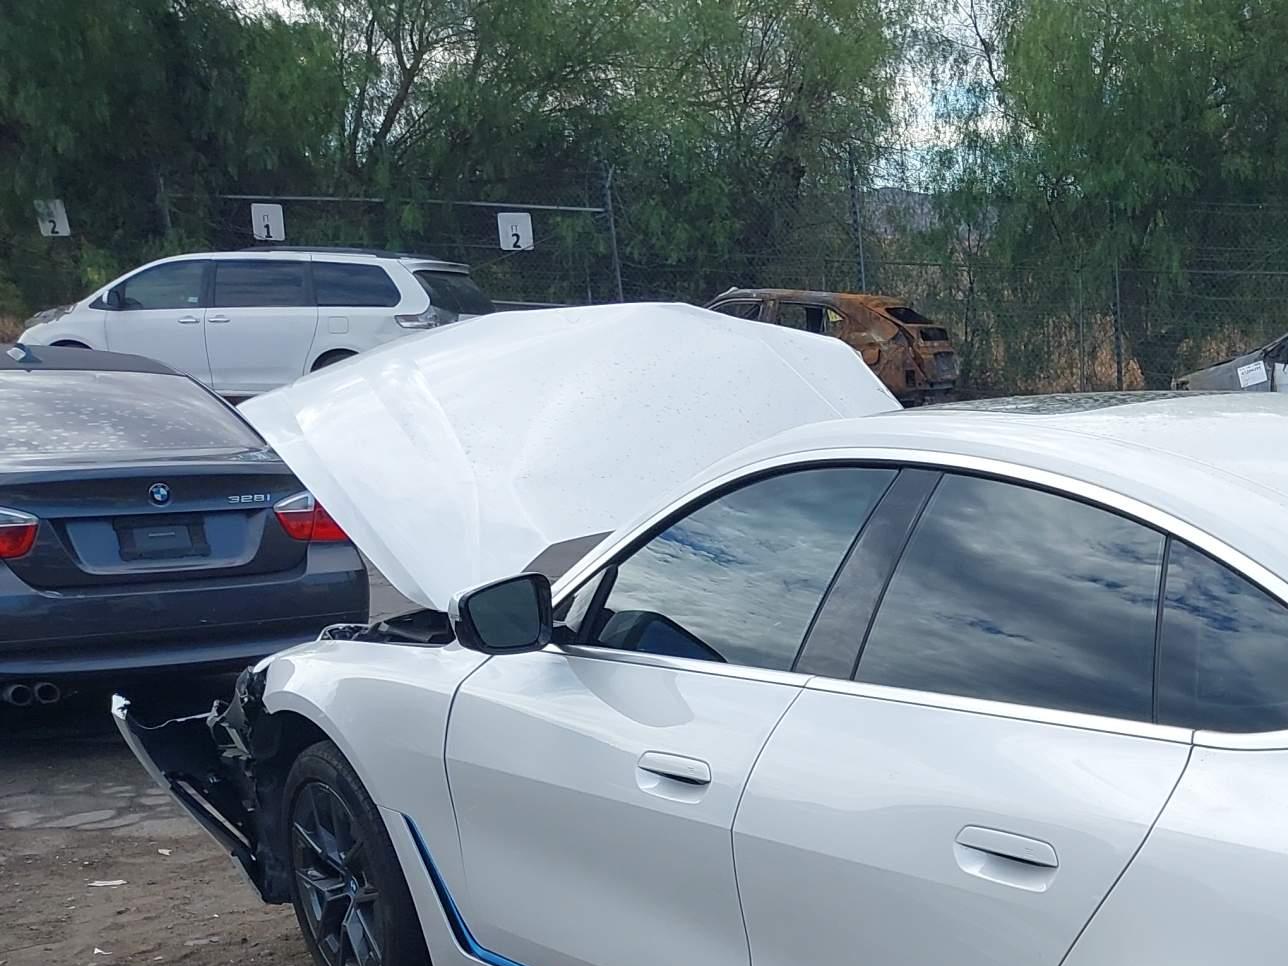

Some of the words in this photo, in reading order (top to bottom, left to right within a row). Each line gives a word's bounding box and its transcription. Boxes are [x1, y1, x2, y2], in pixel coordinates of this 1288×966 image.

[48, 219, 60, 235] 2
[263, 223, 273, 239] 1
[511, 233, 522, 249] 2
